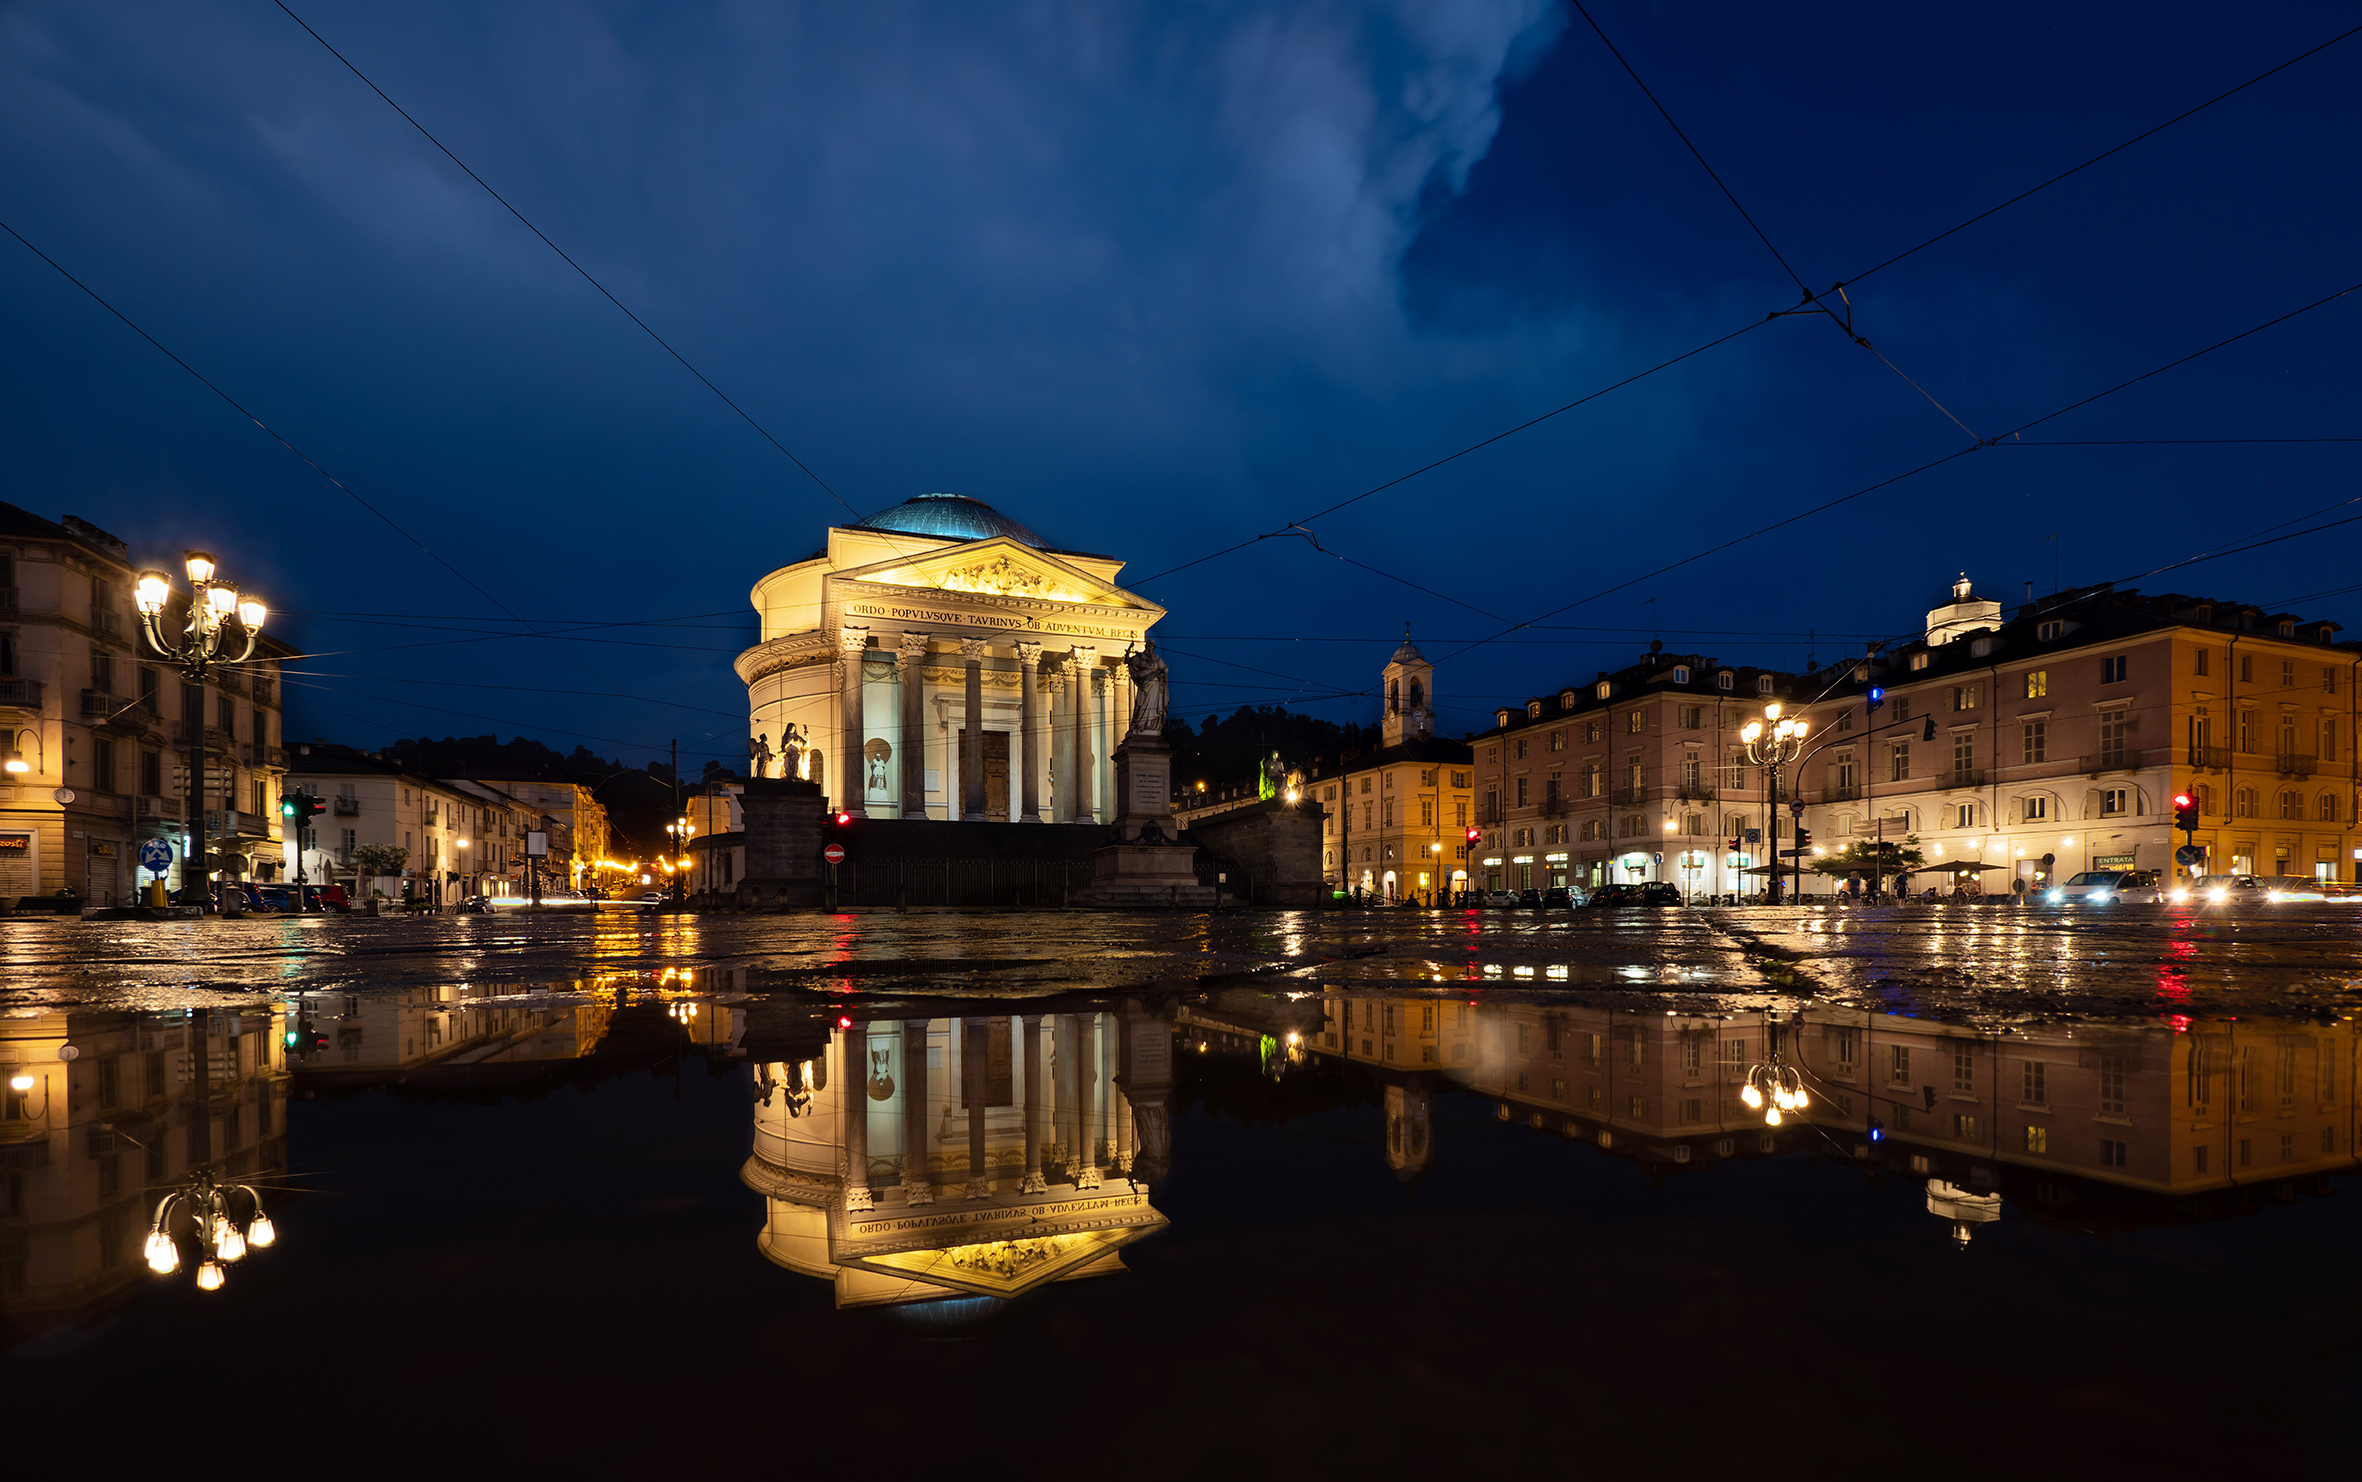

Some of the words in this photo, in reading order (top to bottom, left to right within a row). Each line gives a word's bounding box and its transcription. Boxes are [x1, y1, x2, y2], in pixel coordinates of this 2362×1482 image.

[854, 604, 885, 615] ORDO
[892, 608, 962, 623] POPVLVSQVE
[968, 615, 1022, 628] TAVRINVS
[1027, 621, 1040, 630] OB
[1045, 623, 1105, 636] ADVENTVM
